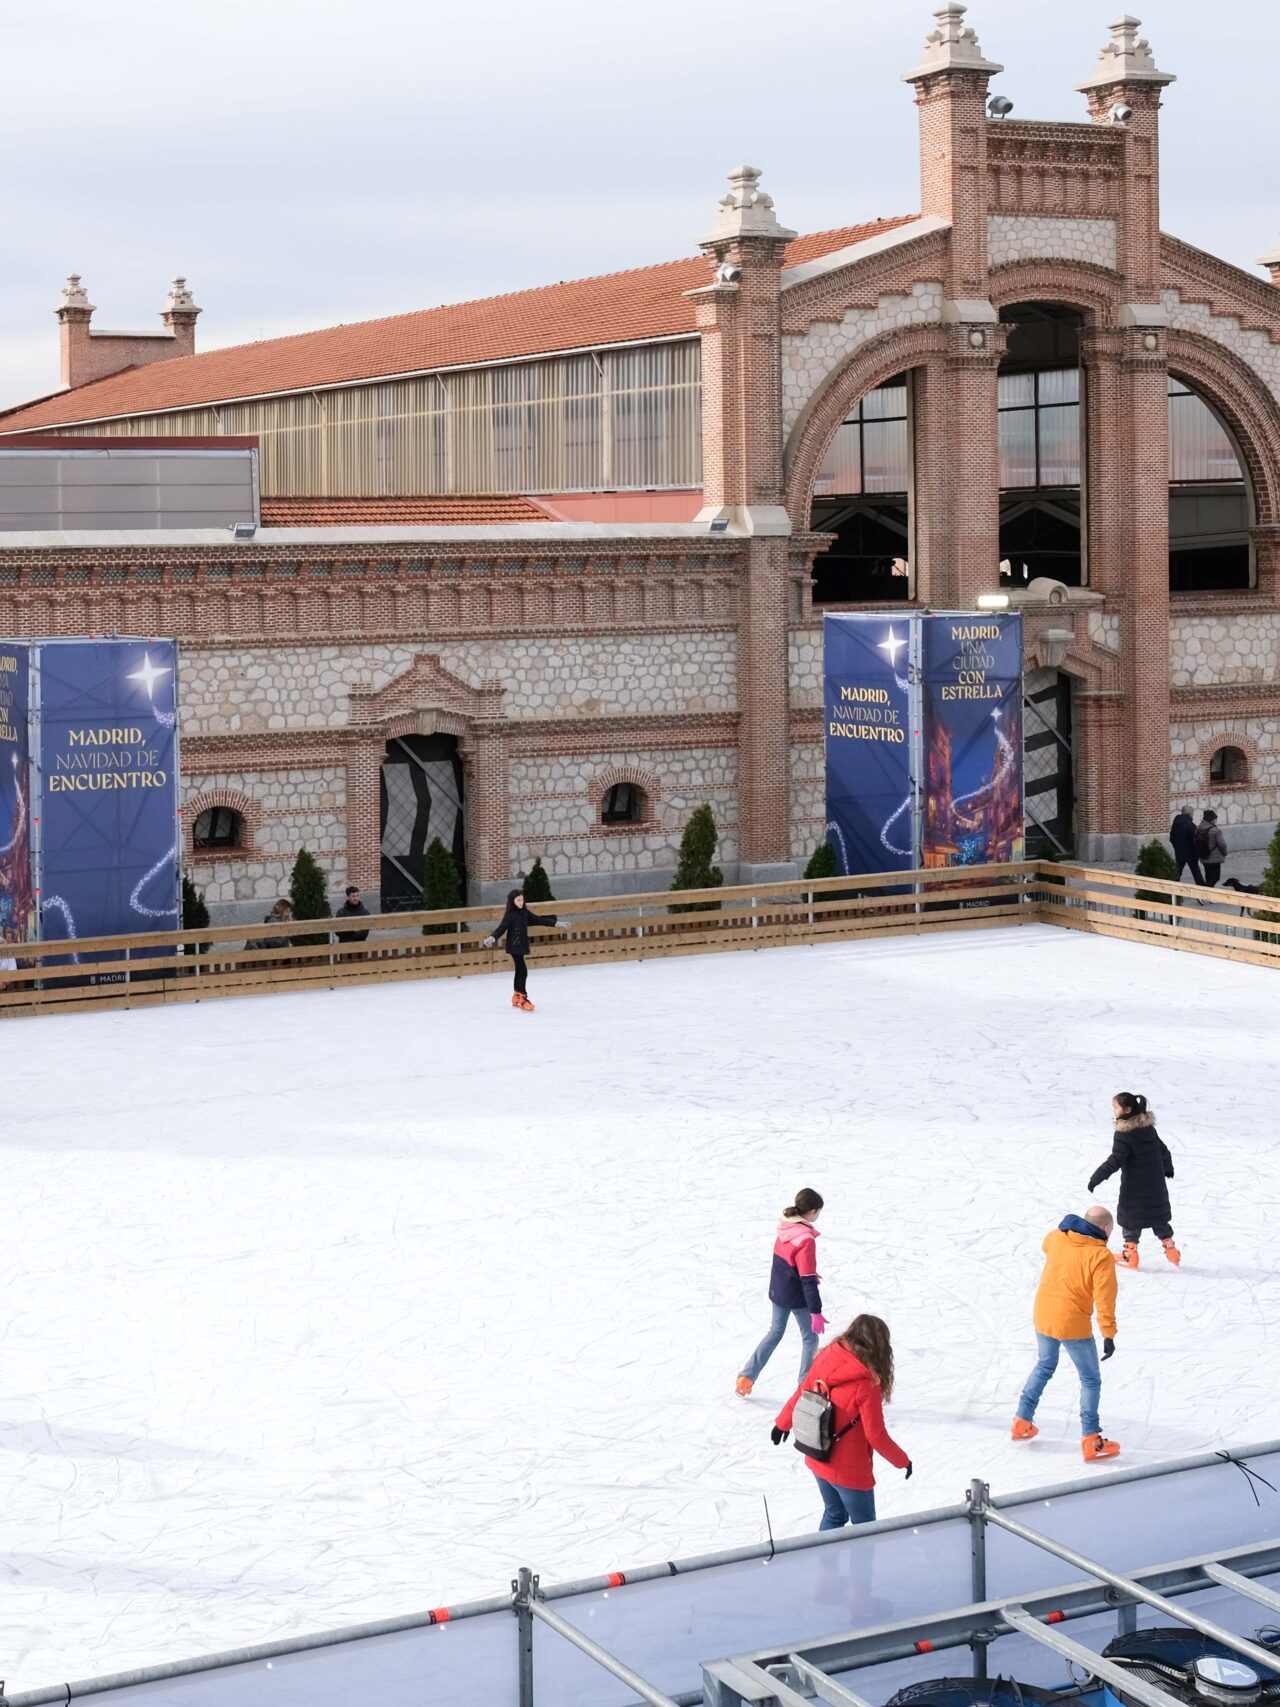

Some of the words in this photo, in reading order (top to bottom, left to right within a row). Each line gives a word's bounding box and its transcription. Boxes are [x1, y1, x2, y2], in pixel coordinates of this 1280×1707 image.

[951, 625, 1002, 640] MADRID,
[961, 641, 986, 654] UNA
[952, 655, 994, 670] CIUDAD
[958, 671, 985, 684] CON
[840, 686, 891, 706] MADRID,
[941, 685, 1003, 700] ESTRELLA
[833, 704, 881, 723] NAVIDAD
[884, 709, 900, 724] DE
[68, 728, 146, 747] MADRID,
[829, 722, 904, 743] ENCUENTRO
[56, 751, 131, 770] NAVIDAD
[136, 750, 159, 767] DE
[49, 771, 167, 792] ENCUENTRO
[100, 975, 129, 983] MADRI
